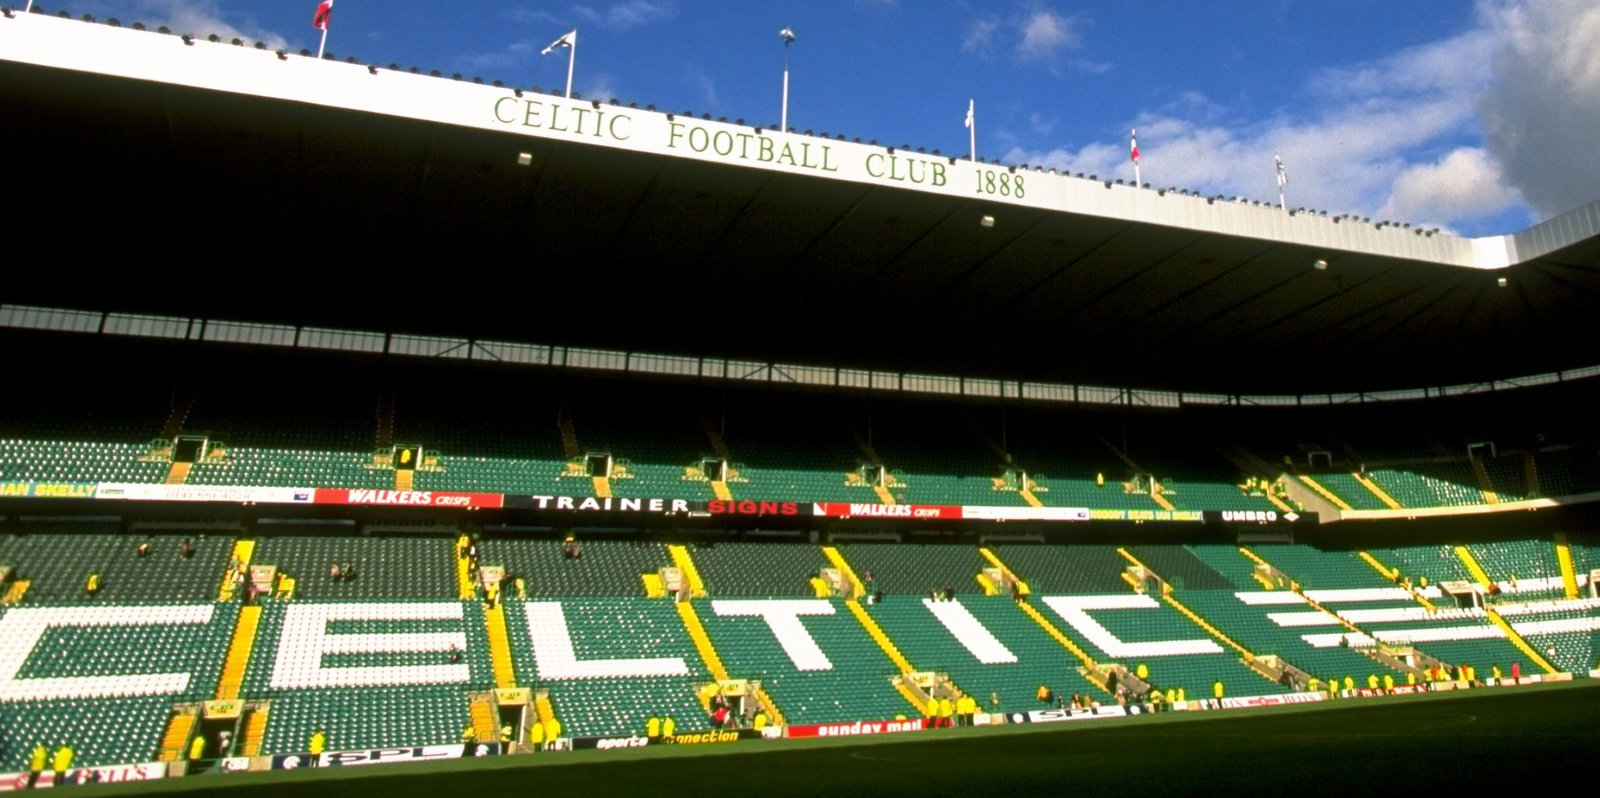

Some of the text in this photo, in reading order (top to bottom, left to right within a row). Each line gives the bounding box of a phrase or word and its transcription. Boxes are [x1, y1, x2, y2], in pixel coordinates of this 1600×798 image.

[494, 96, 1025, 199] CELTIC FOOTBALL CLUB 1888
[0, 482, 29, 496] IAN
[34, 483, 97, 498] SKELLY
[348, 489, 471, 506] WALKERS CRISPS
[533, 495, 798, 515] TRAINER SIGNS
[850, 503, 941, 518] WALKERS CRISPS
[1222, 510, 1277, 522] UMBRO
[0, 591, 1224, 700] CELTIC
[1039, 706, 1115, 719] SPL
[818, 719, 922, 737] sunday mail
[597, 729, 739, 749] sports nnection
[328, 745, 449, 766] SPL
